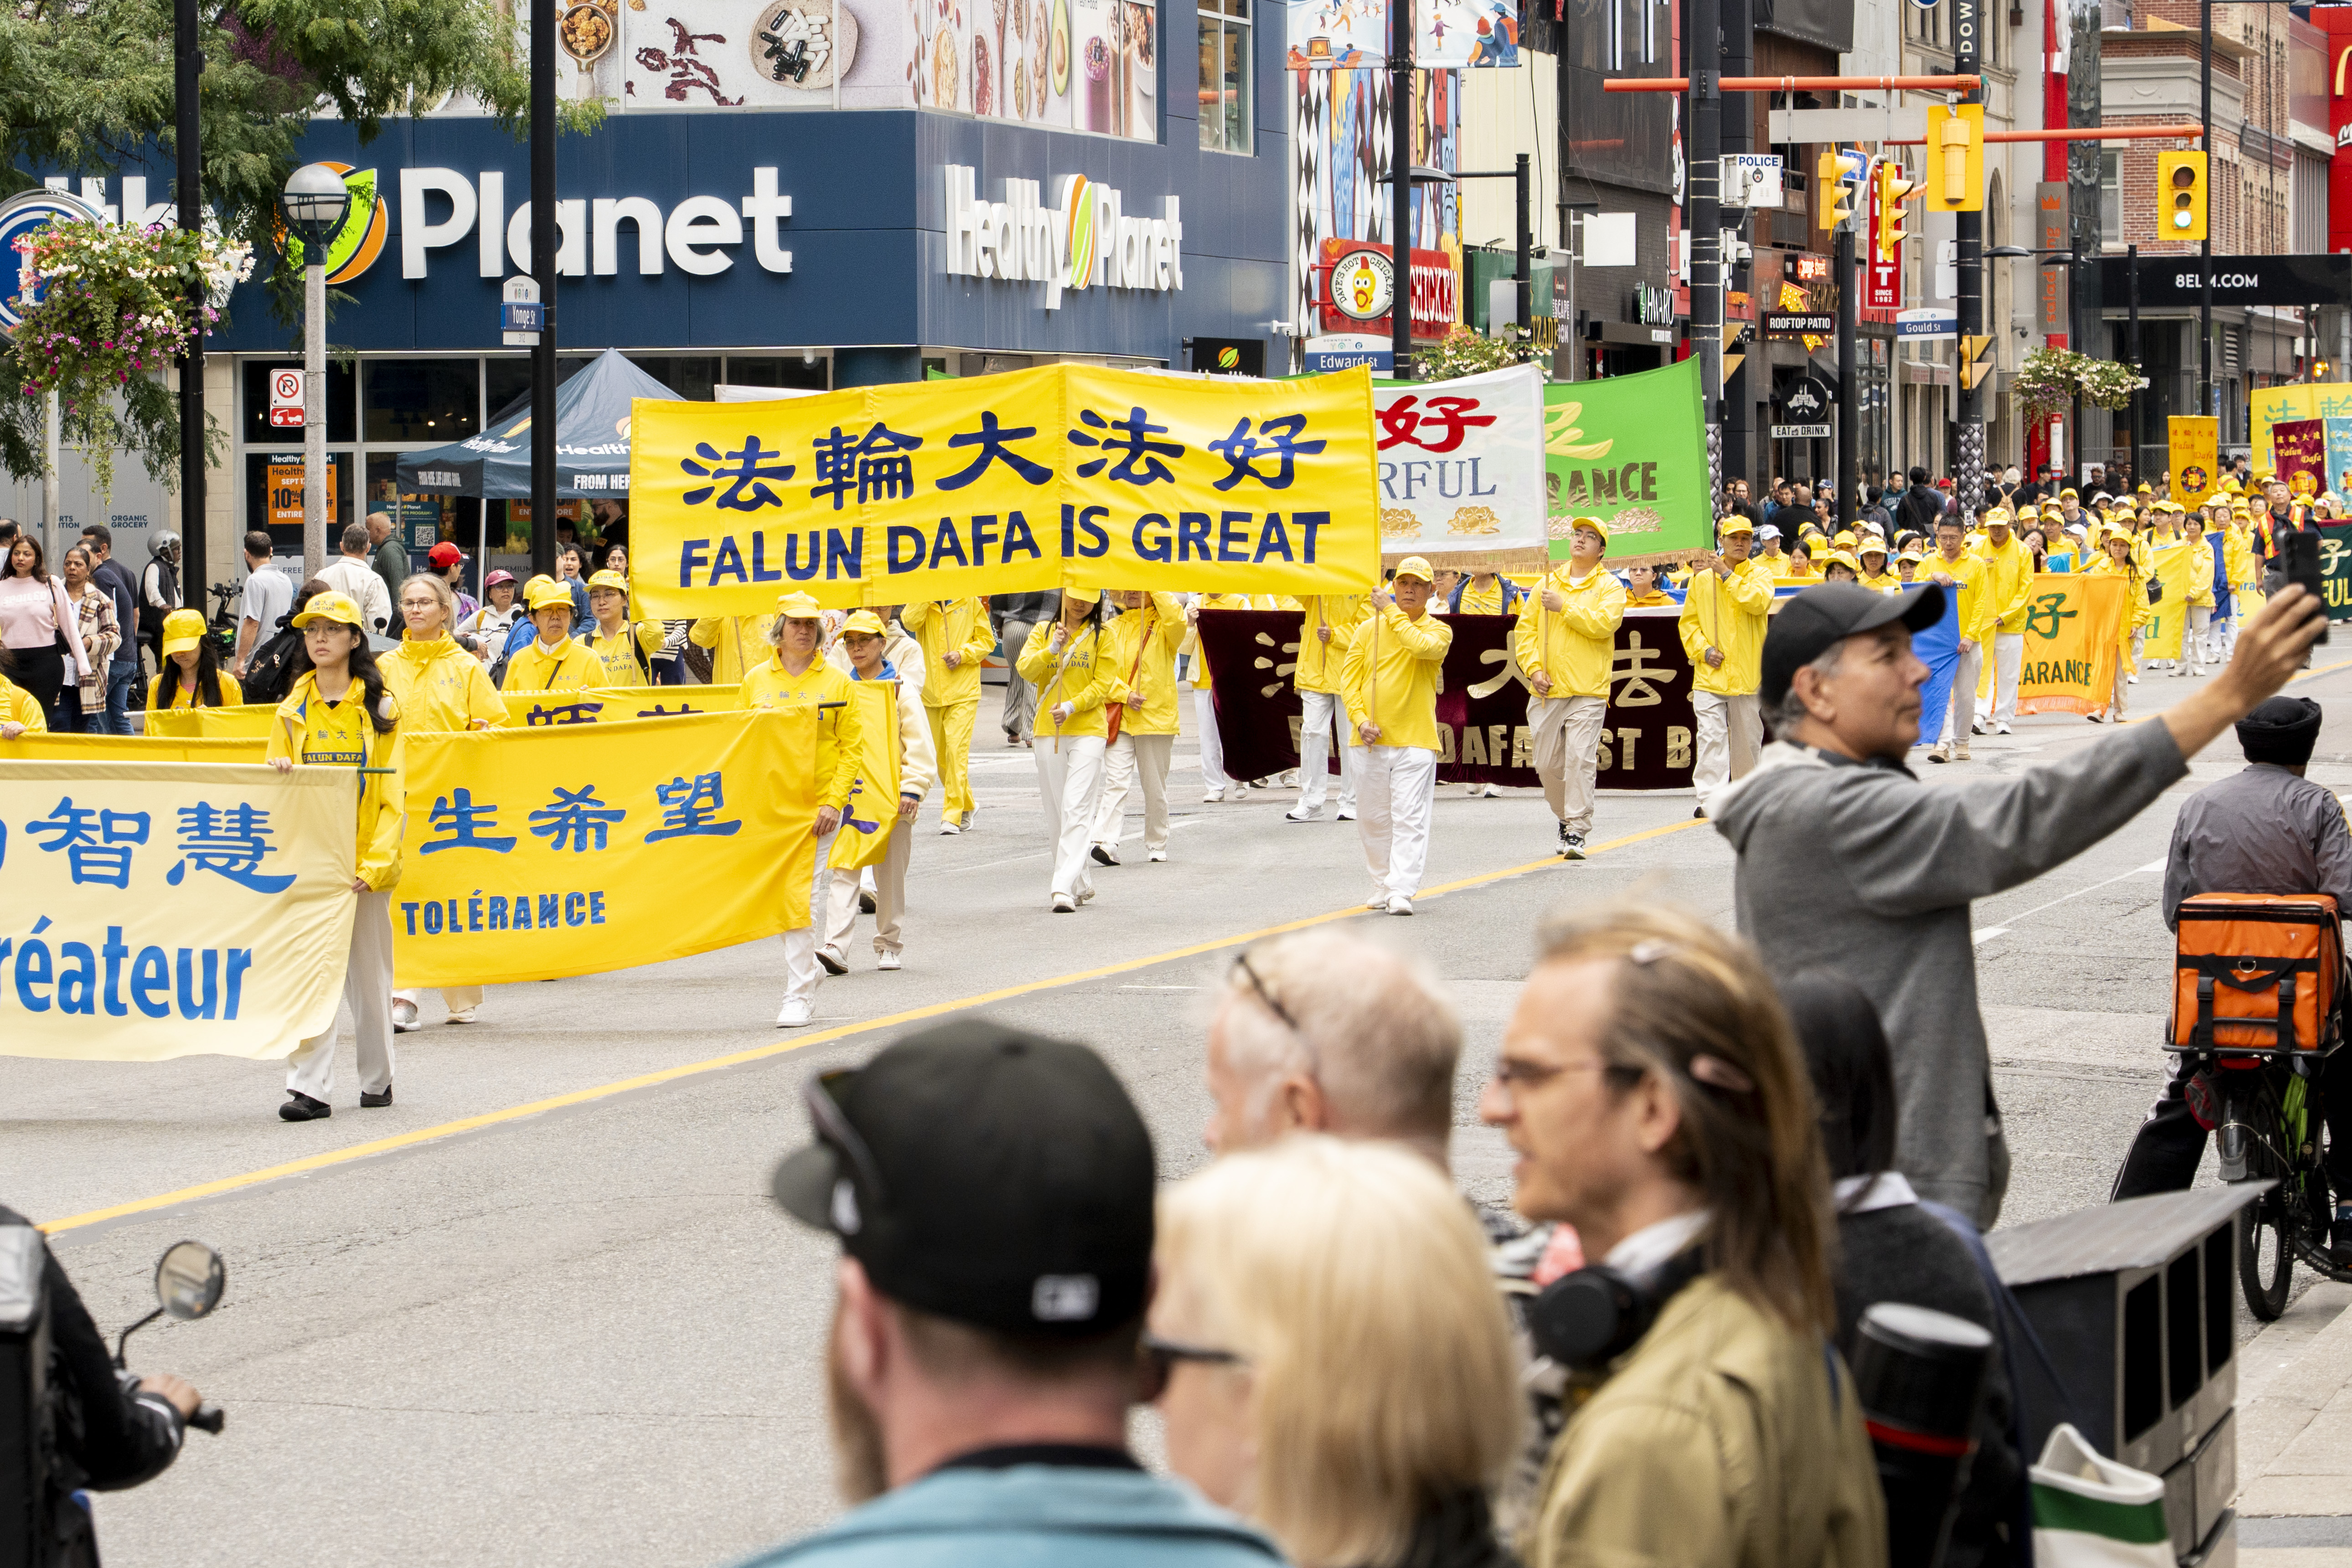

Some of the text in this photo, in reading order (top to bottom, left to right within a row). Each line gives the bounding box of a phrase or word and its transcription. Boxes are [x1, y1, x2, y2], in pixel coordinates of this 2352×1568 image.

[1739, 156, 1778, 166] POLICE
[400, 167, 792, 279] Planet
[945, 164, 1183, 310] Healthy Planet
[1335, 257, 1394, 304] DAVE'S HOT CHICKEN
[2042, 271, 2056, 322] salad
[1647, 286, 1674, 325] HWARO
[512, 305, 535, 329] Yonge St
[1770, 317, 1831, 329] ROOFTOP PATIO
[1906, 322, 1932, 332] Gould
[1320, 354, 1378, 368] Edward St
[1375, 395, 1497, 453] 好
[1777, 426, 1825, 435] EAT DRINK
[556, 444, 631, 455] Health
[2172, 441, 2194, 450] Falun
[2279, 447, 2302, 457] Falun
[272, 455, 300, 464] Healthy
[680, 406, 1327, 512] 法輪大法好
[2301, 453, 2321, 465] Dafa
[574, 474, 630, 490] FROM HER
[277, 510, 303, 518] ENTIRE
[680, 503, 1331, 588] FALUN DAFA IS GREAT
[614, 664, 632, 672] DAFA
[1071, 660, 1090, 669] DAFA
[762, 690, 826, 701] 法輪大法
[303, 753, 362, 763] FALUN DAFA
[400, 888, 606, 936] TOLÉRANCE
